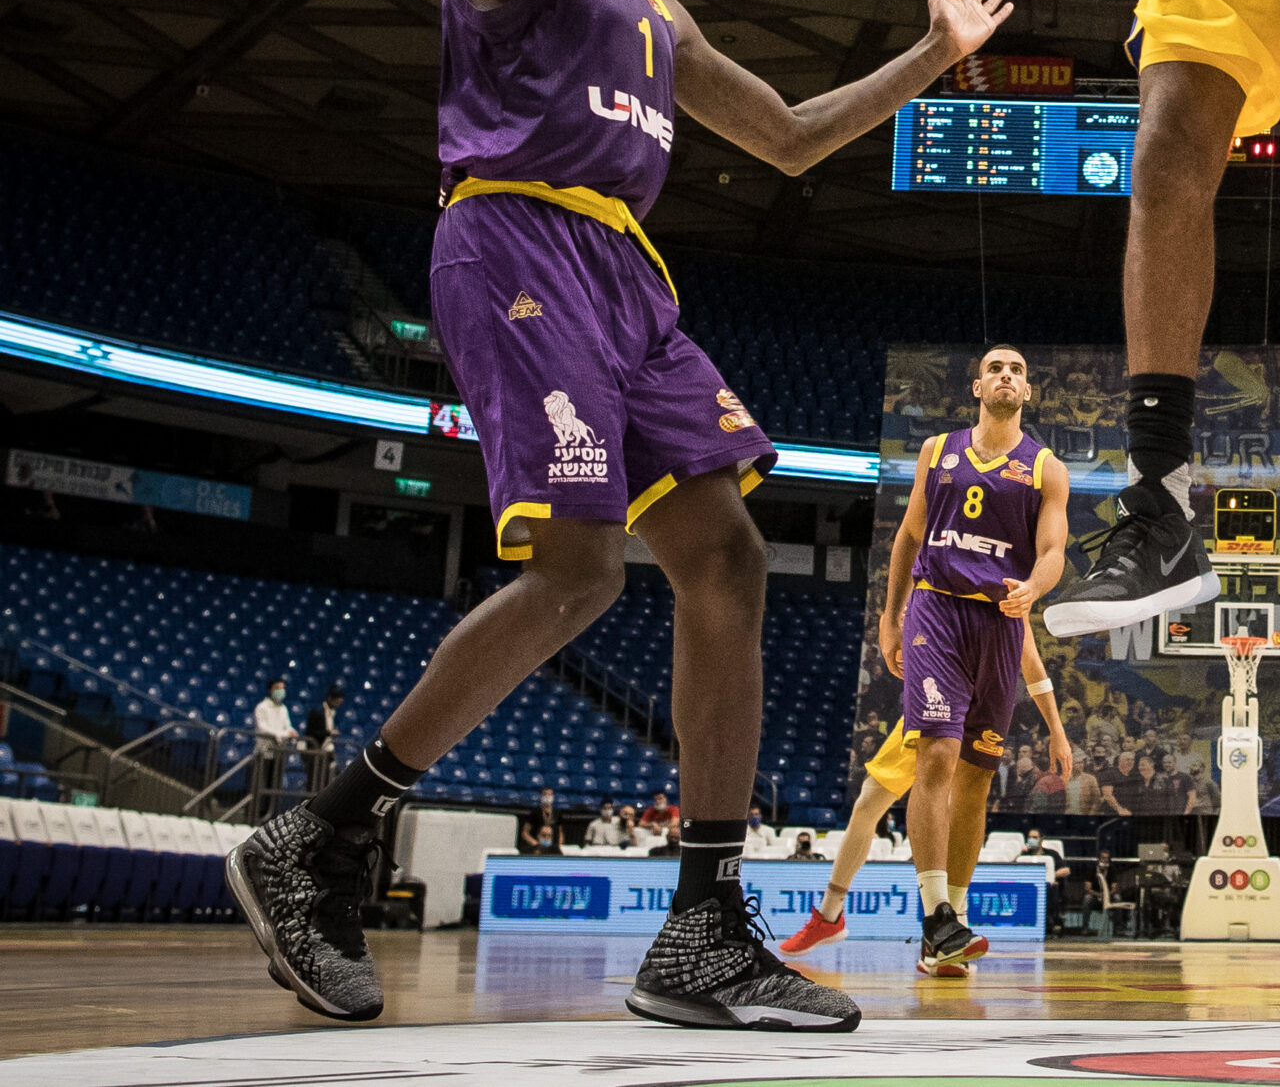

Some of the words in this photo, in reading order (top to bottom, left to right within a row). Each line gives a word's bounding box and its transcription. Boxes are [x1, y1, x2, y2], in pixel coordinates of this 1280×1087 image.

[637, 17, 654, 78] 1
[1010, 64, 1072, 86] טוטו
[587, 85, 674, 153] UNE
[508, 303, 543, 321] PEAK
[383, 445, 396, 465] 4
[554, 447, 607, 462] מסיעי
[548, 463, 608, 476] שאשא
[963, 486, 984, 519] 8
[927, 530, 1013, 558] UNET
[1227, 542, 1264, 551] DHL
[511, 884, 592, 910] עמינח
[847, 884, 908, 915] לישו
[974, 892, 1019, 917] עמי
